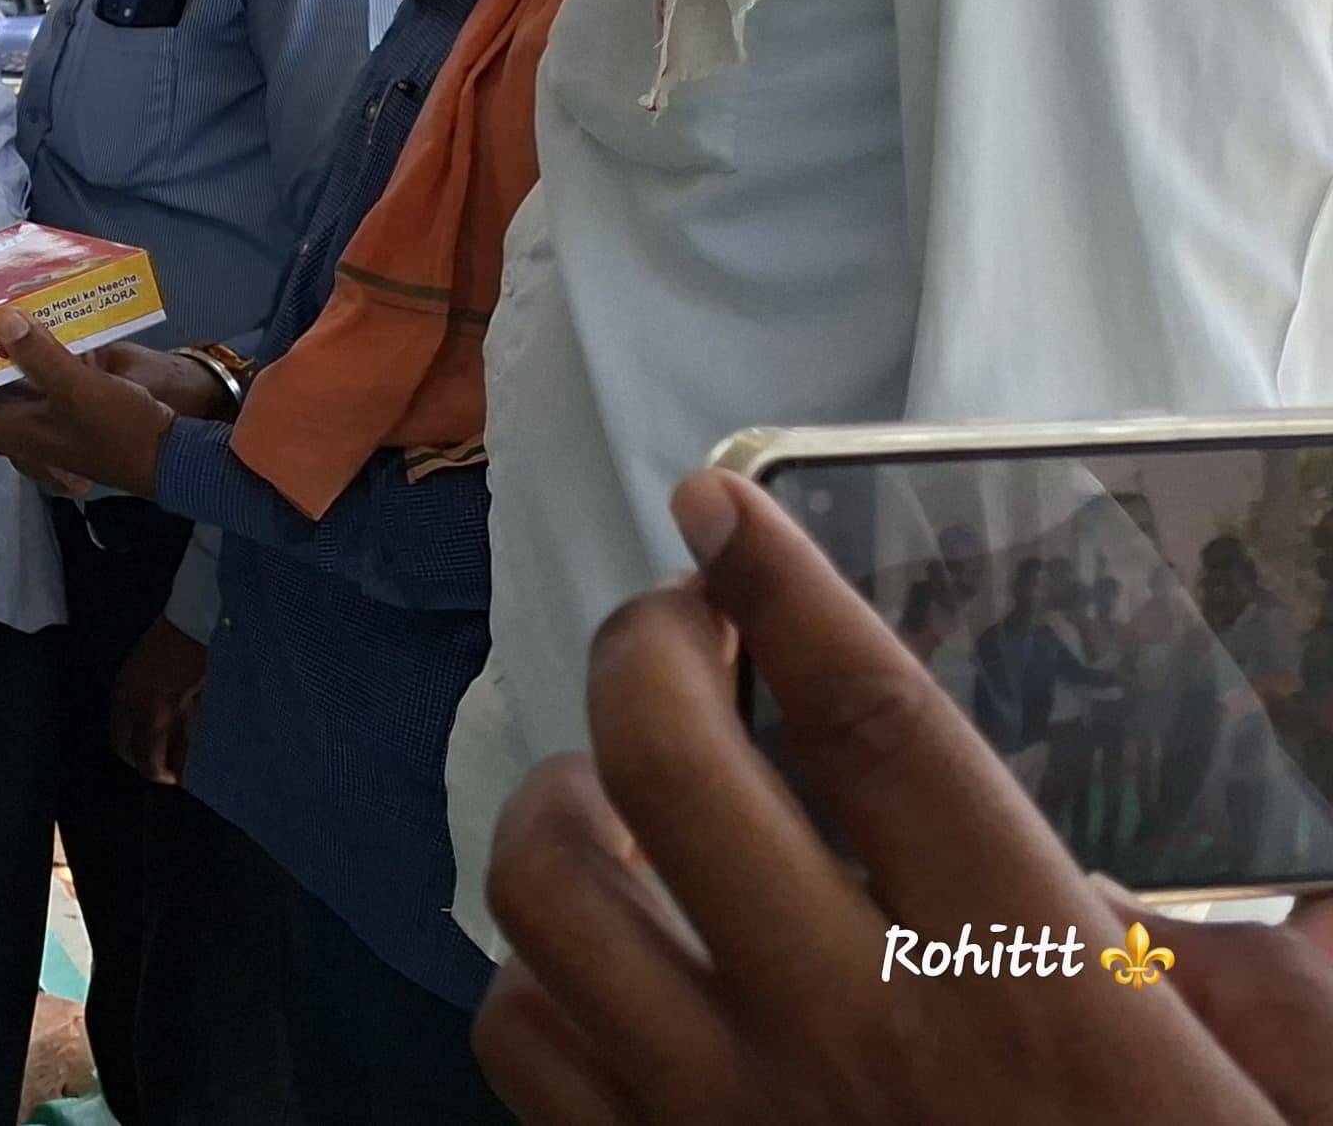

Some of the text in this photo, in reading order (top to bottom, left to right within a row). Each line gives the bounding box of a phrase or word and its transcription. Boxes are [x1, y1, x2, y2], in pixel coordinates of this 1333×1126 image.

[32, 306, 50, 318] rag
[52, 293, 82, 312] Hotel
[84, 289, 96, 301] ke
[42, 316, 63, 331] pali
[99, 288, 138, 310] JAORA
